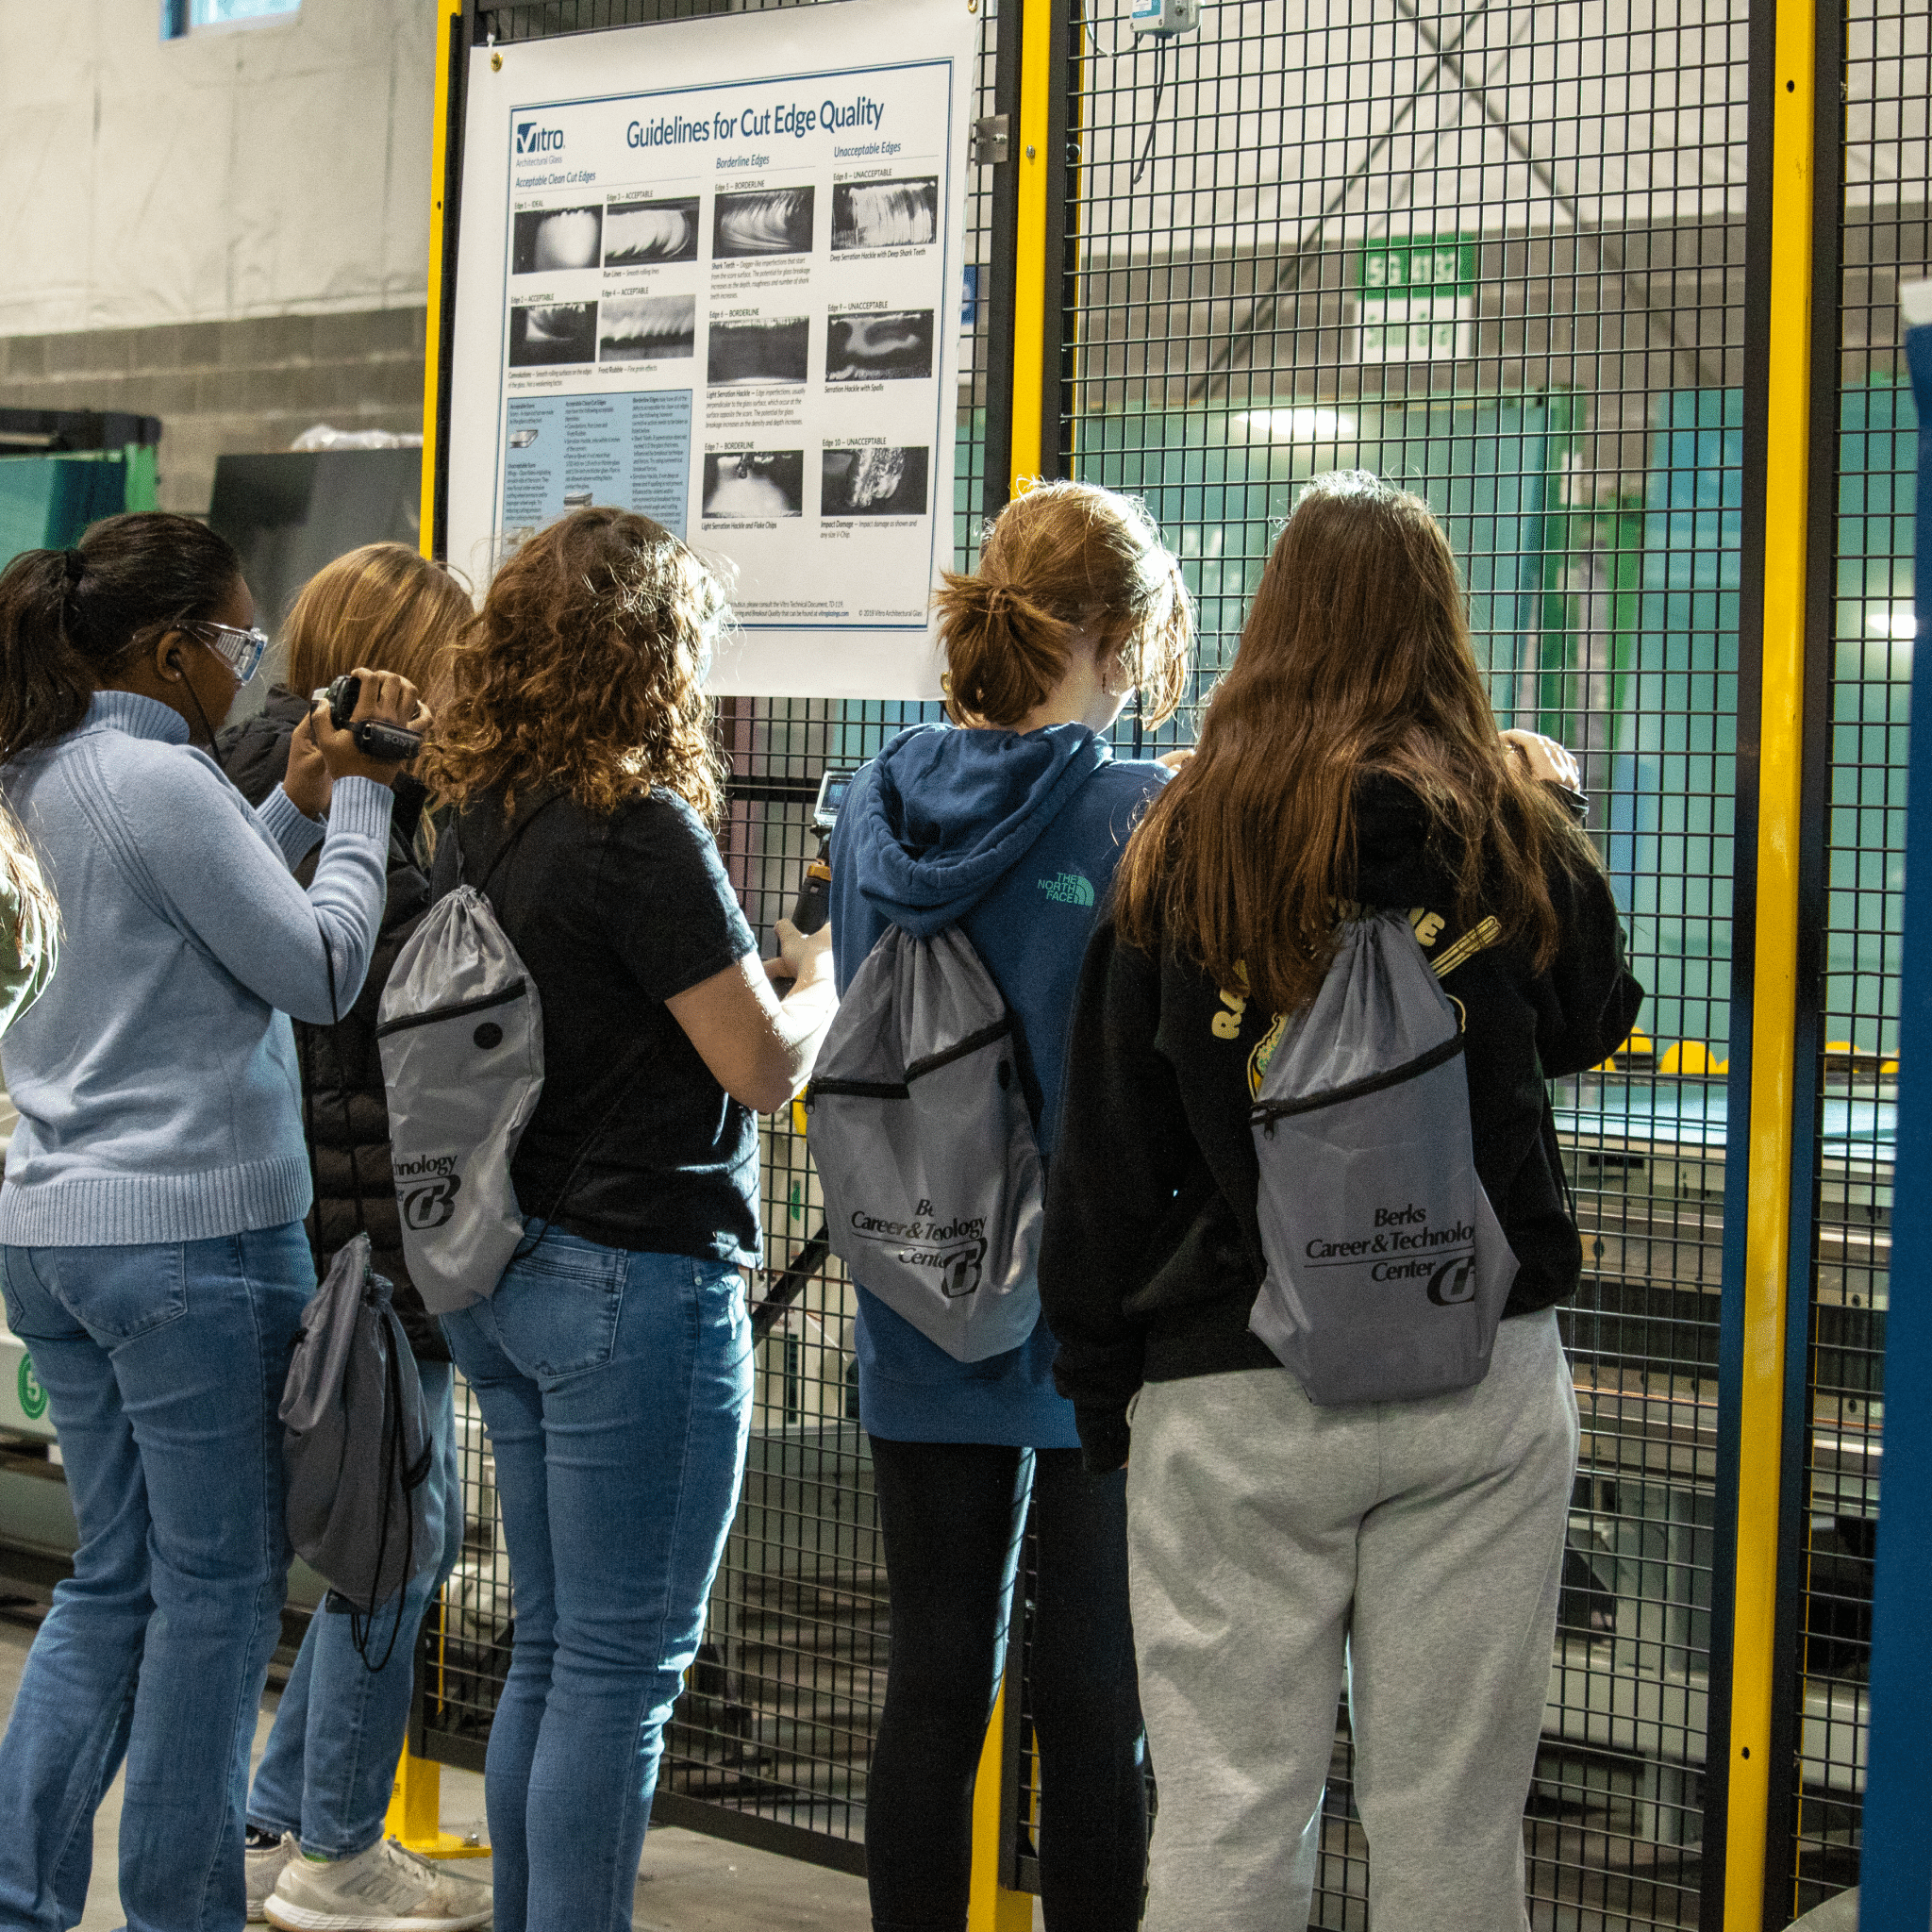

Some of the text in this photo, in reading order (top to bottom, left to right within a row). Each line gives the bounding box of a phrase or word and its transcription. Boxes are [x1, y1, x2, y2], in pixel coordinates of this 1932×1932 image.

[626, 96, 885, 149] Guidelines for Cut Edge Quality
[516, 122, 564, 154] Vitro
[834, 142, 901, 158] Unacceptable Edges
[516, 156, 562, 167] Architectural Glass
[716, 154, 769, 169] Borderline Edges
[515, 171, 596, 188] Acceptable Clean Cut Edges
[833, 174, 843, 182] Edge
[853, 168, 891, 178] UNACCEPTABLE
[734, 180, 764, 190] BORDERLINE
[625, 191, 653, 199] ACCEPTABLE
[528, 293, 554, 302] ACCEPTABLE
[620, 287, 648, 295] ACCEPTABLE
[708, 311, 719, 320] Edge
[729, 308, 759, 317] BORDERLINE
[827, 304, 838, 313] Edge
[847, 301, 888, 310] UNACCEPTABLE
[871, 384, 884, 392] Spalls
[705, 443, 715, 452] Edge
[724, 441, 754, 450] BORDERLINE
[822, 439, 833, 447] Edge
[846, 437, 886, 446] UNACCEPTABLE
[701, 523, 711, 531] Light
[1038, 879, 1075, 893] NORTH
[1058, 873, 1076, 885] THE
[1046, 890, 1073, 904] FACE
[393, 1154, 458, 1176] hnology
[1374, 1204, 1426, 1226] Berks
[851, 1210, 907, 1236] Career
[1307, 1221, 1474, 1259] Career & Technolo
[1371, 1261, 1437, 1282] Center
